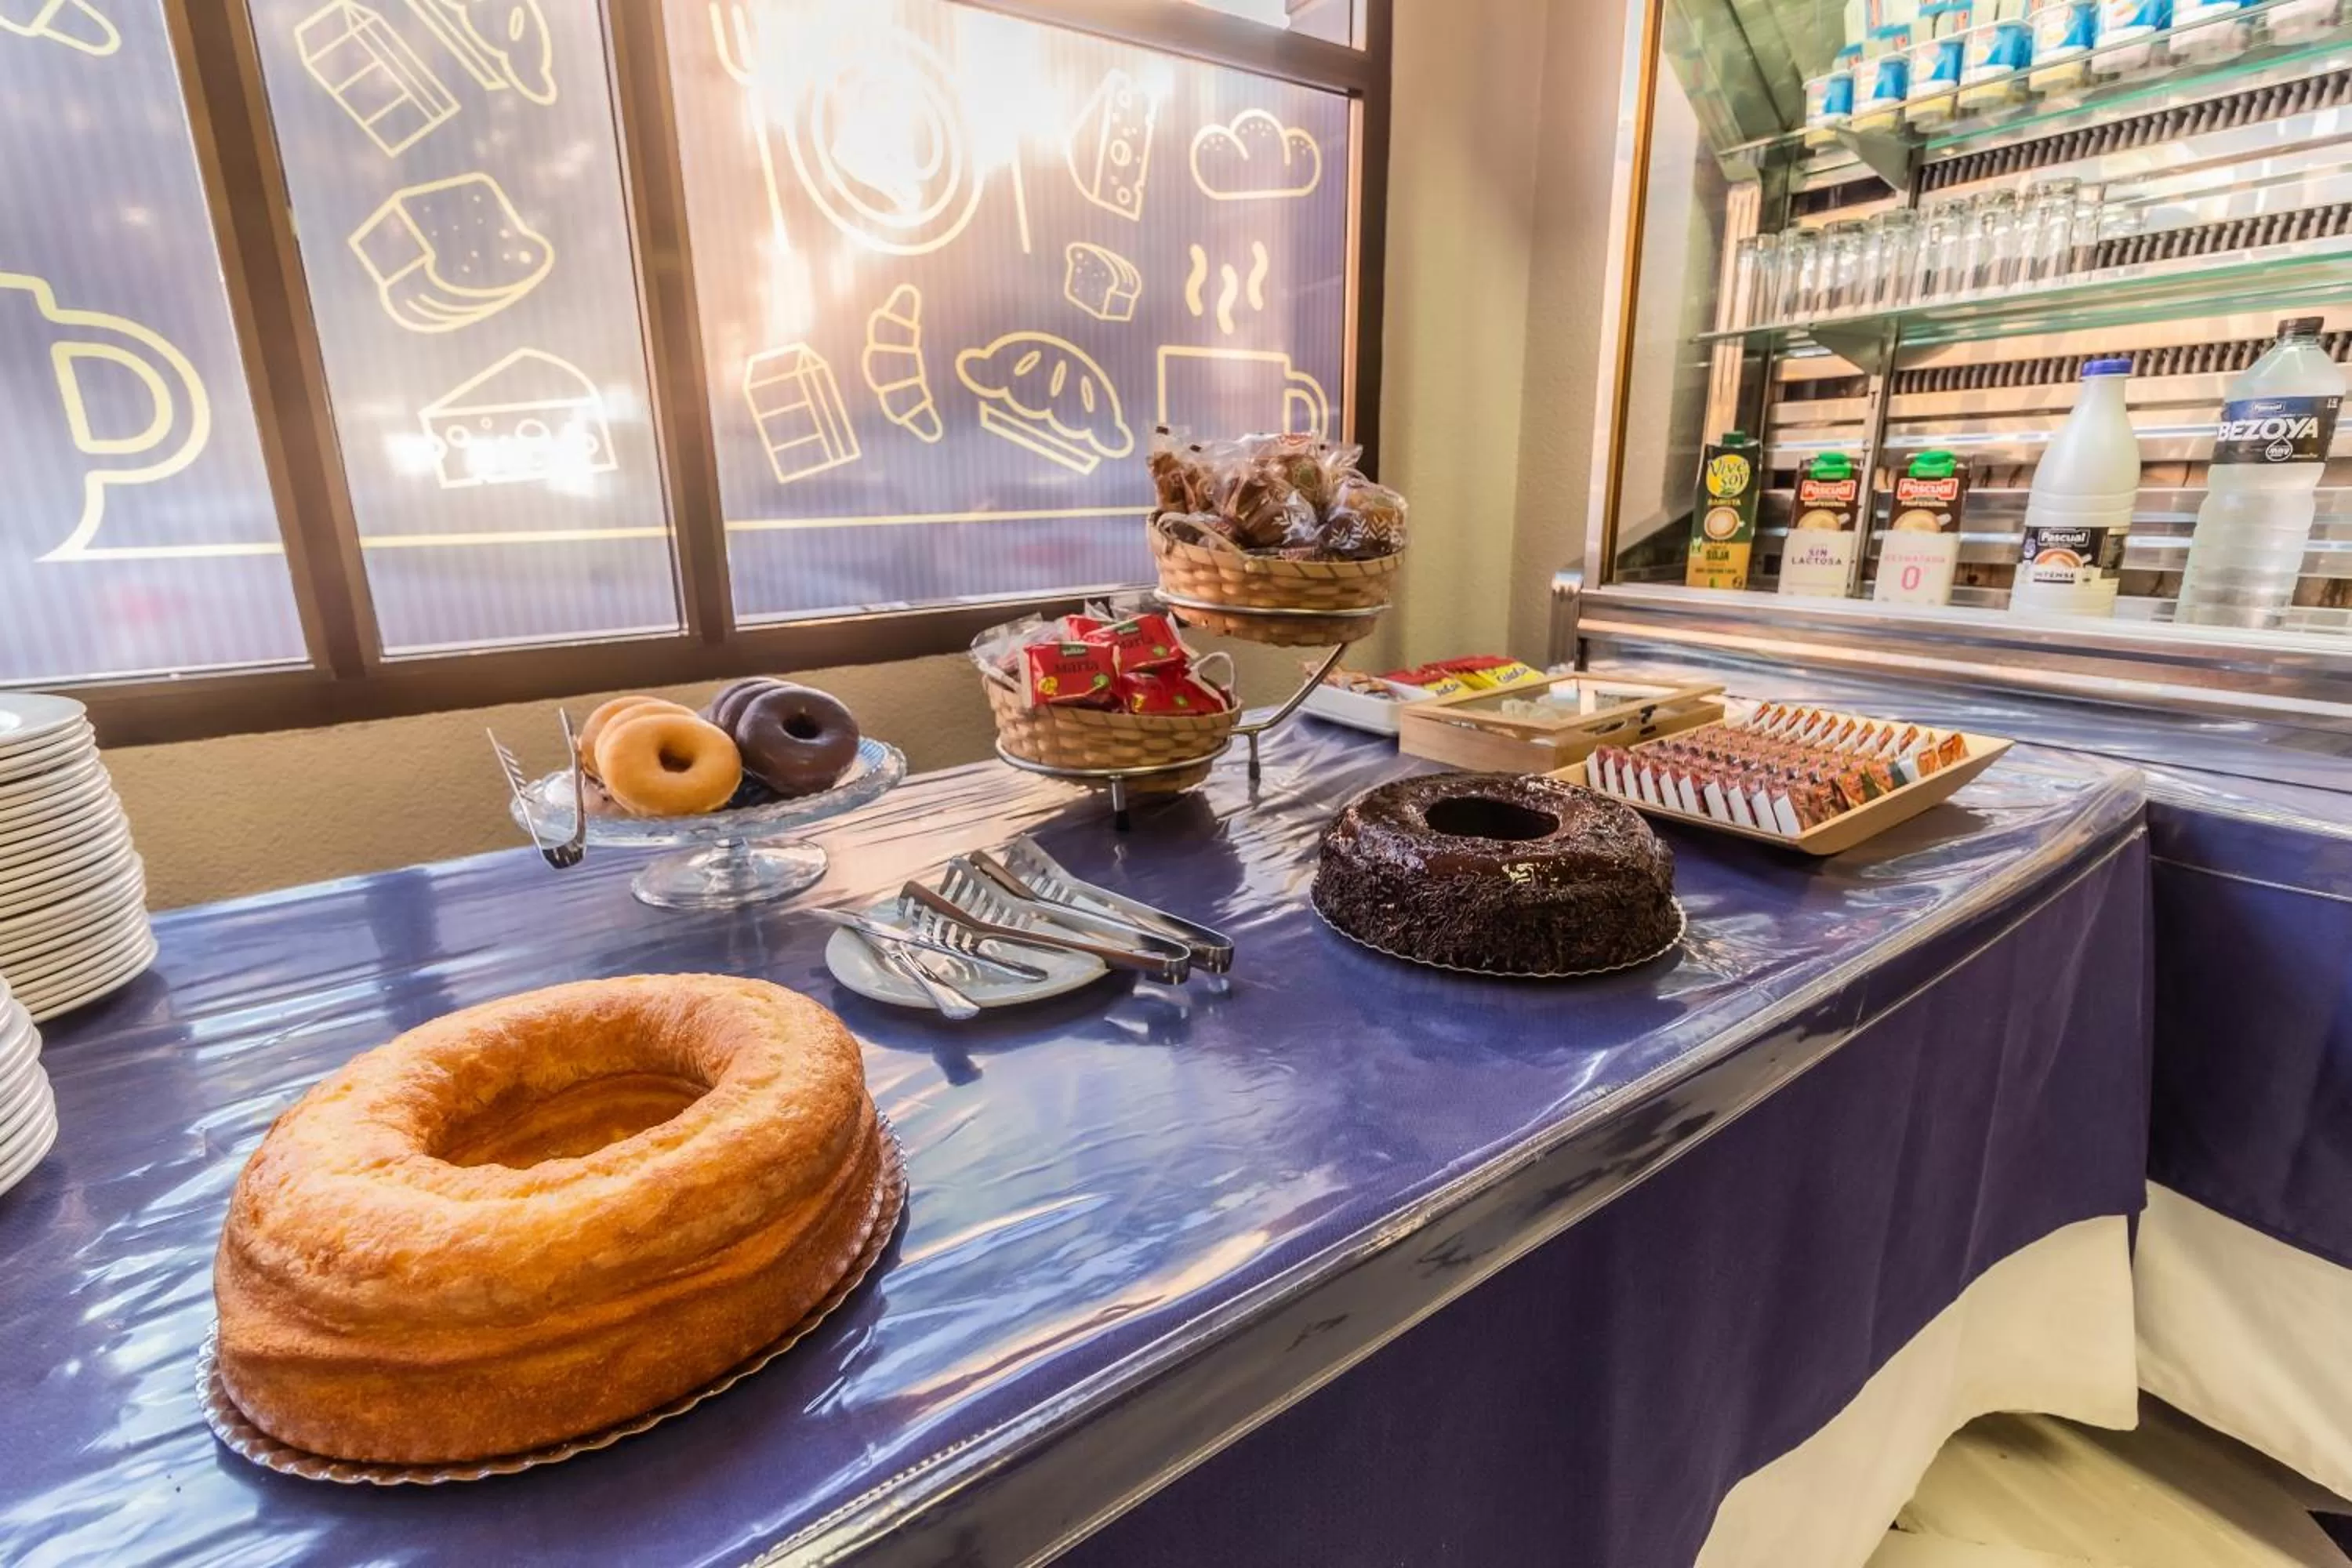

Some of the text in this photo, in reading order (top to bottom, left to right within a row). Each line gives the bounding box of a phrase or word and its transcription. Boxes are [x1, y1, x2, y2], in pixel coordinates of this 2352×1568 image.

[2216, 417, 2318, 441] BEZOYA
[1805, 483, 1851, 495] Pascual
[1901, 482, 1953, 494] Pascual
[2041, 531, 2086, 543] Pascual
[1809, 548, 1828, 557] SIN
[1791, 557, 1842, 565] LACTOSA
